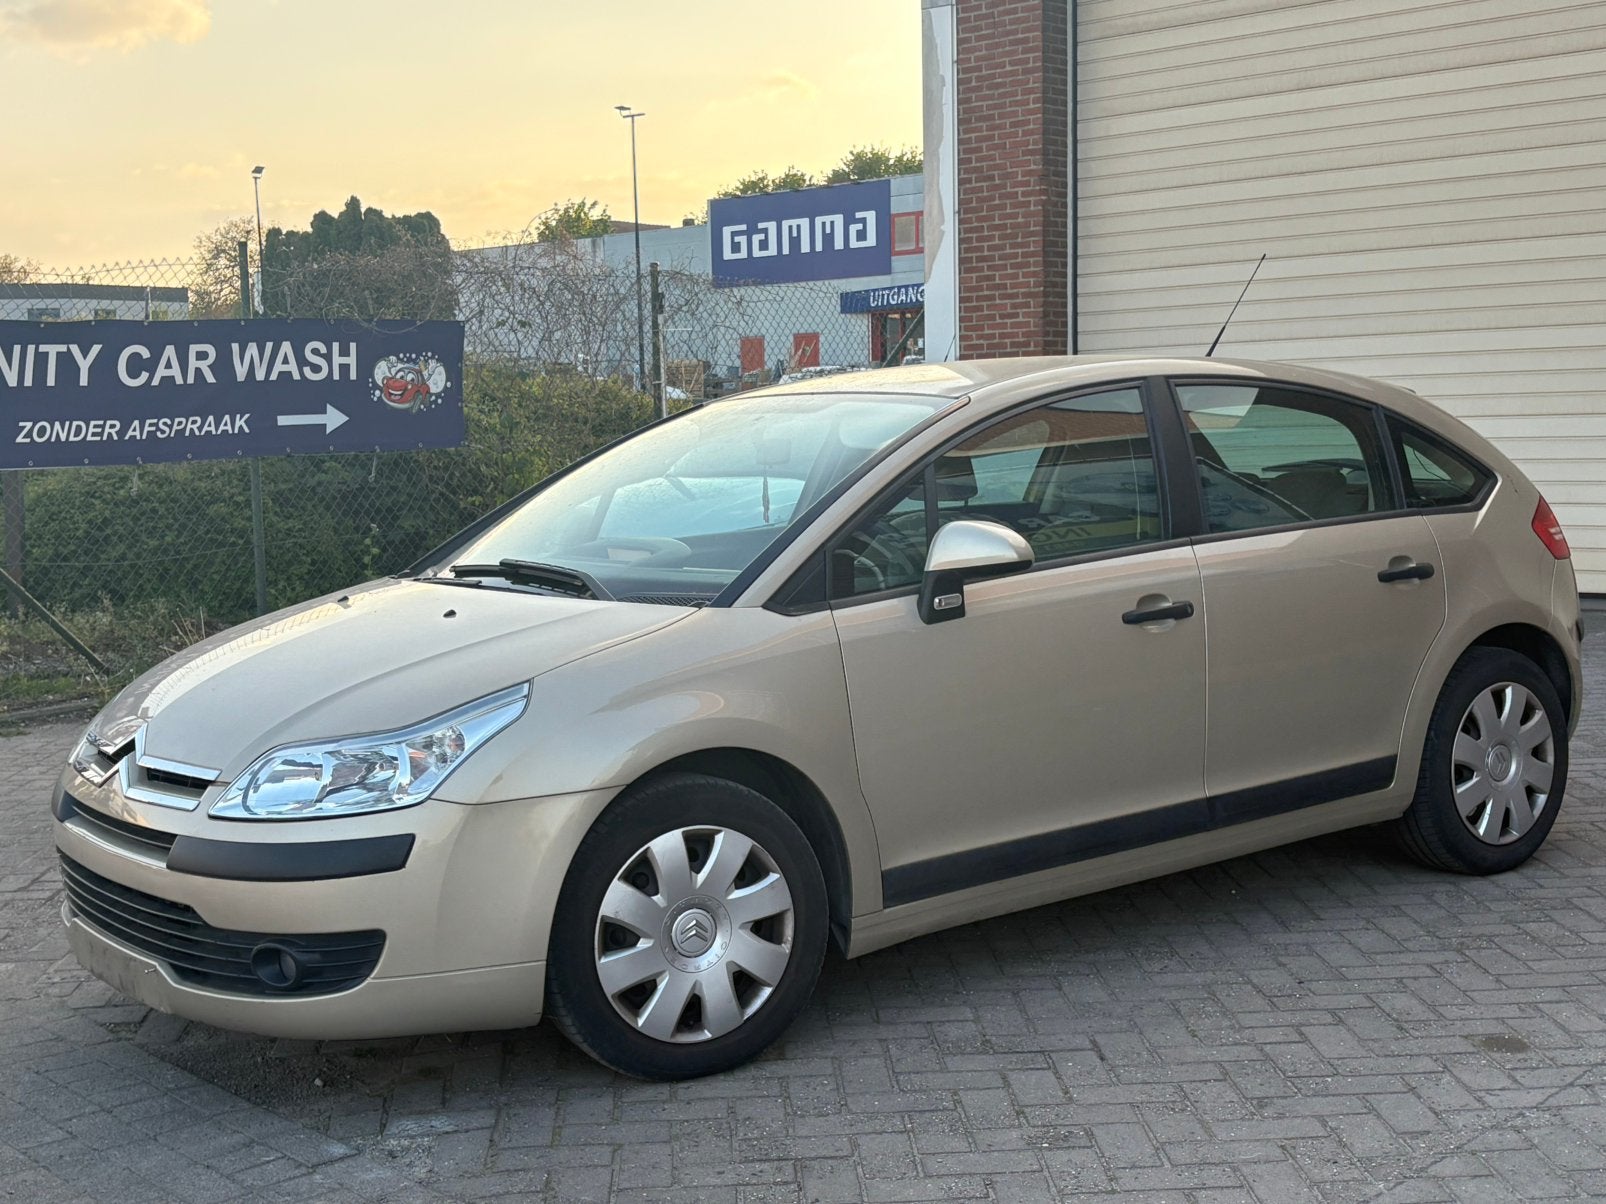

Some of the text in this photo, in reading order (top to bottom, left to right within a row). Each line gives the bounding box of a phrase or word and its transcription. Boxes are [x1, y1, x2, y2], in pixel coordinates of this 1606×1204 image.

[117, 344, 217, 387] CAR
[231, 341, 357, 382] WASH
[16, 413, 250, 443] ZONDER AFSPRAAK
